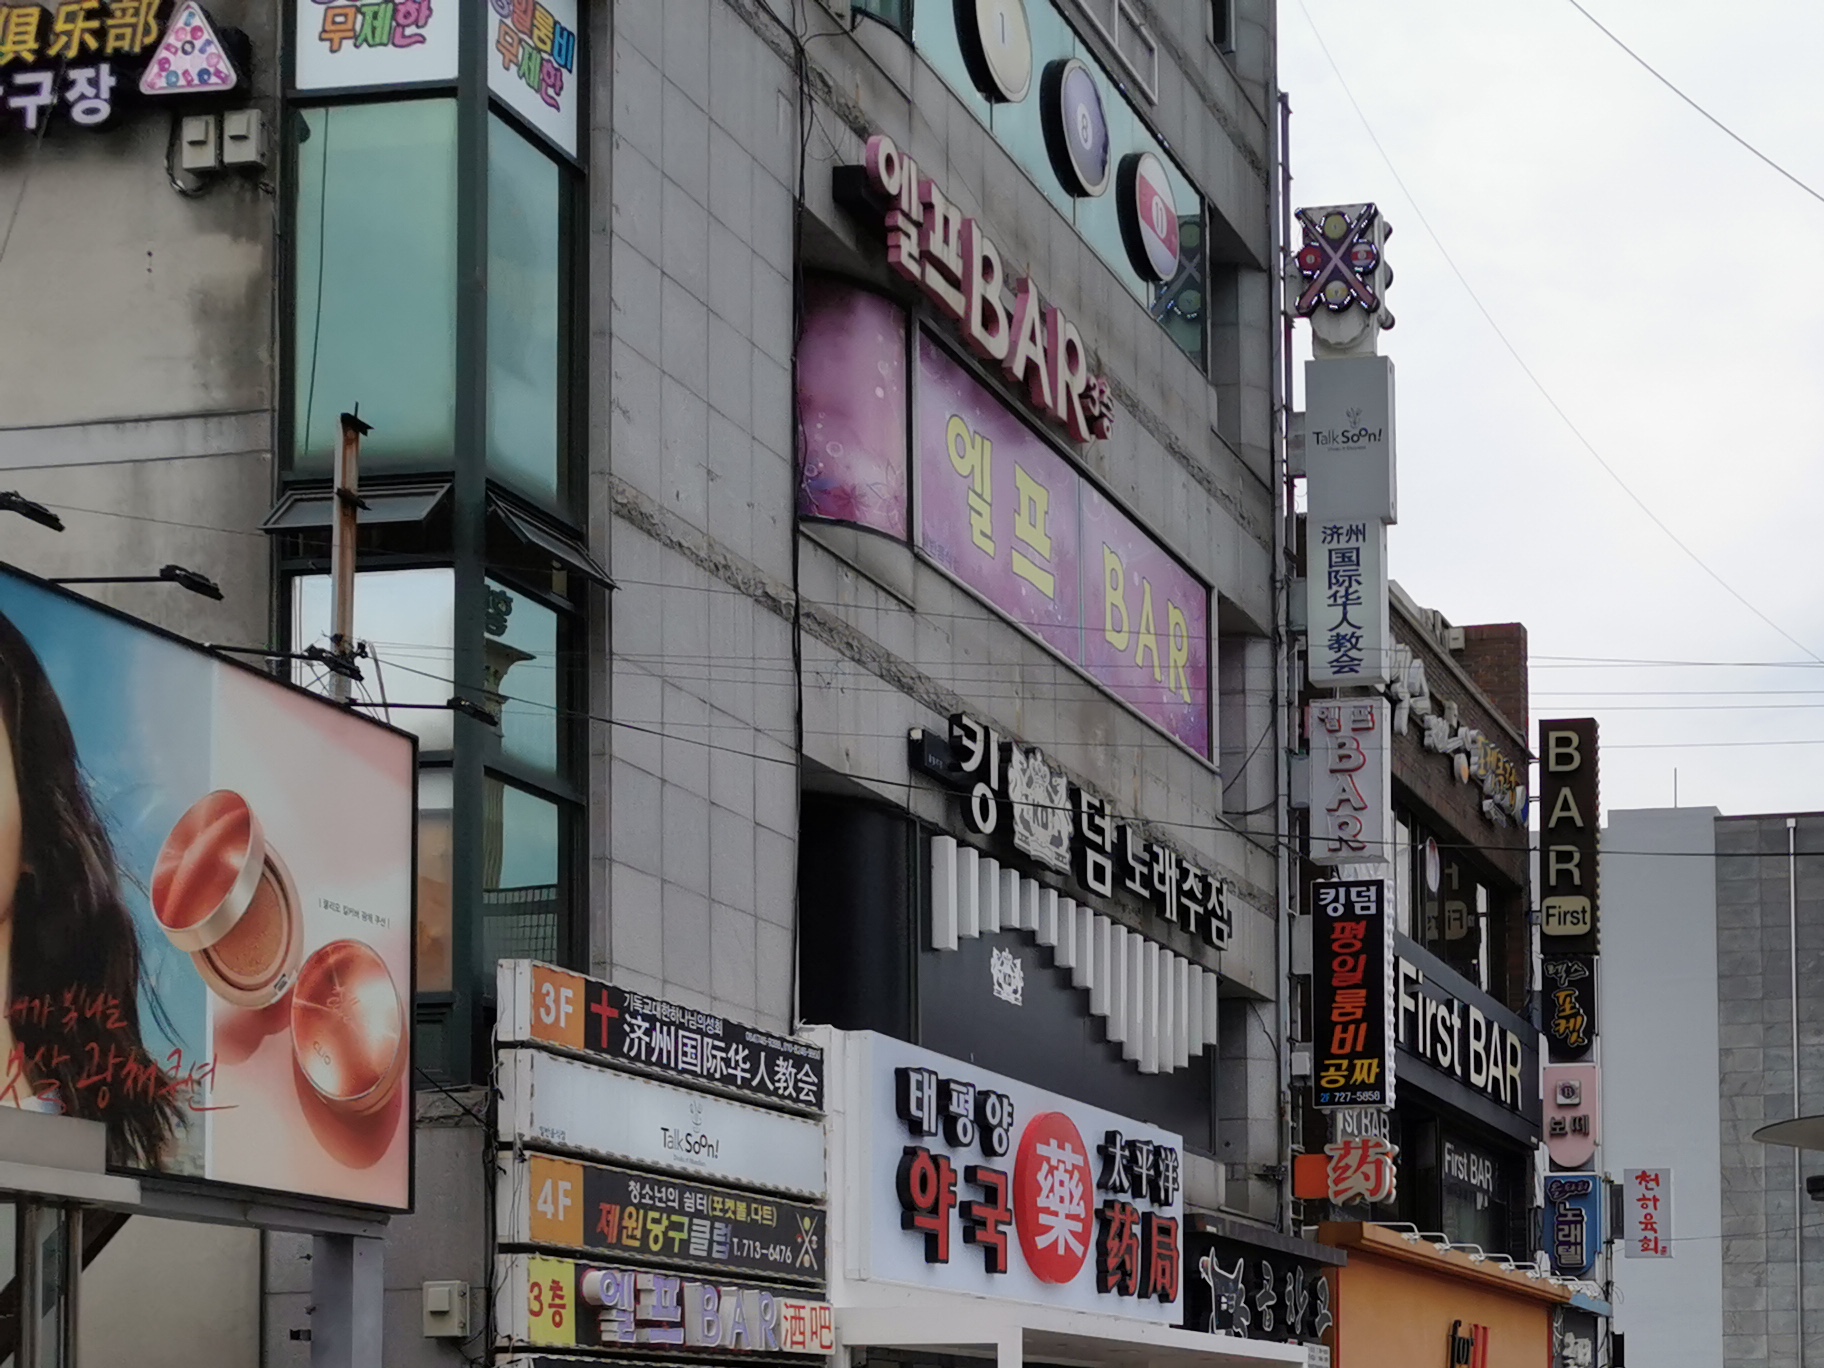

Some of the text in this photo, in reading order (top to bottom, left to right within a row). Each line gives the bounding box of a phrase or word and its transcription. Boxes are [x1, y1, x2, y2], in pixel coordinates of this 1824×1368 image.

[318, 0, 433, 53] 무제한
[0, 63, 117, 130] 구장
[496, 21, 564, 112] 무제한
[946, 414, 1192, 705] 엘프 BAR
[1321, 524, 1367, 545] 济州
[1327, 546, 1365, 676] 国际华人教会
[1328, 736, 1368, 853] BAR
[1548, 730, 1585, 887] BAR
[1116, 821, 1233, 951] 노래주점
[1319, 885, 1378, 917] 킹덤
[1545, 905, 1588, 927] First
[539, 982, 574, 1029] 3F
[1398, 957, 1522, 1111] First BAR
[622, 1013, 819, 1104] 济州国际华人教会
[1320, 1058, 1380, 1088] 공짜
[895, 1067, 1014, 1156] 태평양
[537, 1178, 572, 1221] 4F
[628, 1180, 679, 1210] 청소년의
[1035, 1138, 1085, 1259] 藥
[1097, 1130, 1180, 1207] 太平洋
[1326, 1137, 1391, 1204] 药
[1444, 1142, 1493, 1193] First BAR
[597, 1202, 733, 1260] 제원당구클럽
[896, 1147, 1012, 1274] 약국
[1634, 1169, 1661, 1255] 천하육회
[1095, 1200, 1180, 1303] 药局
[528, 1278, 567, 1329] 3층
[783, 1302, 833, 1350] 酒吧
